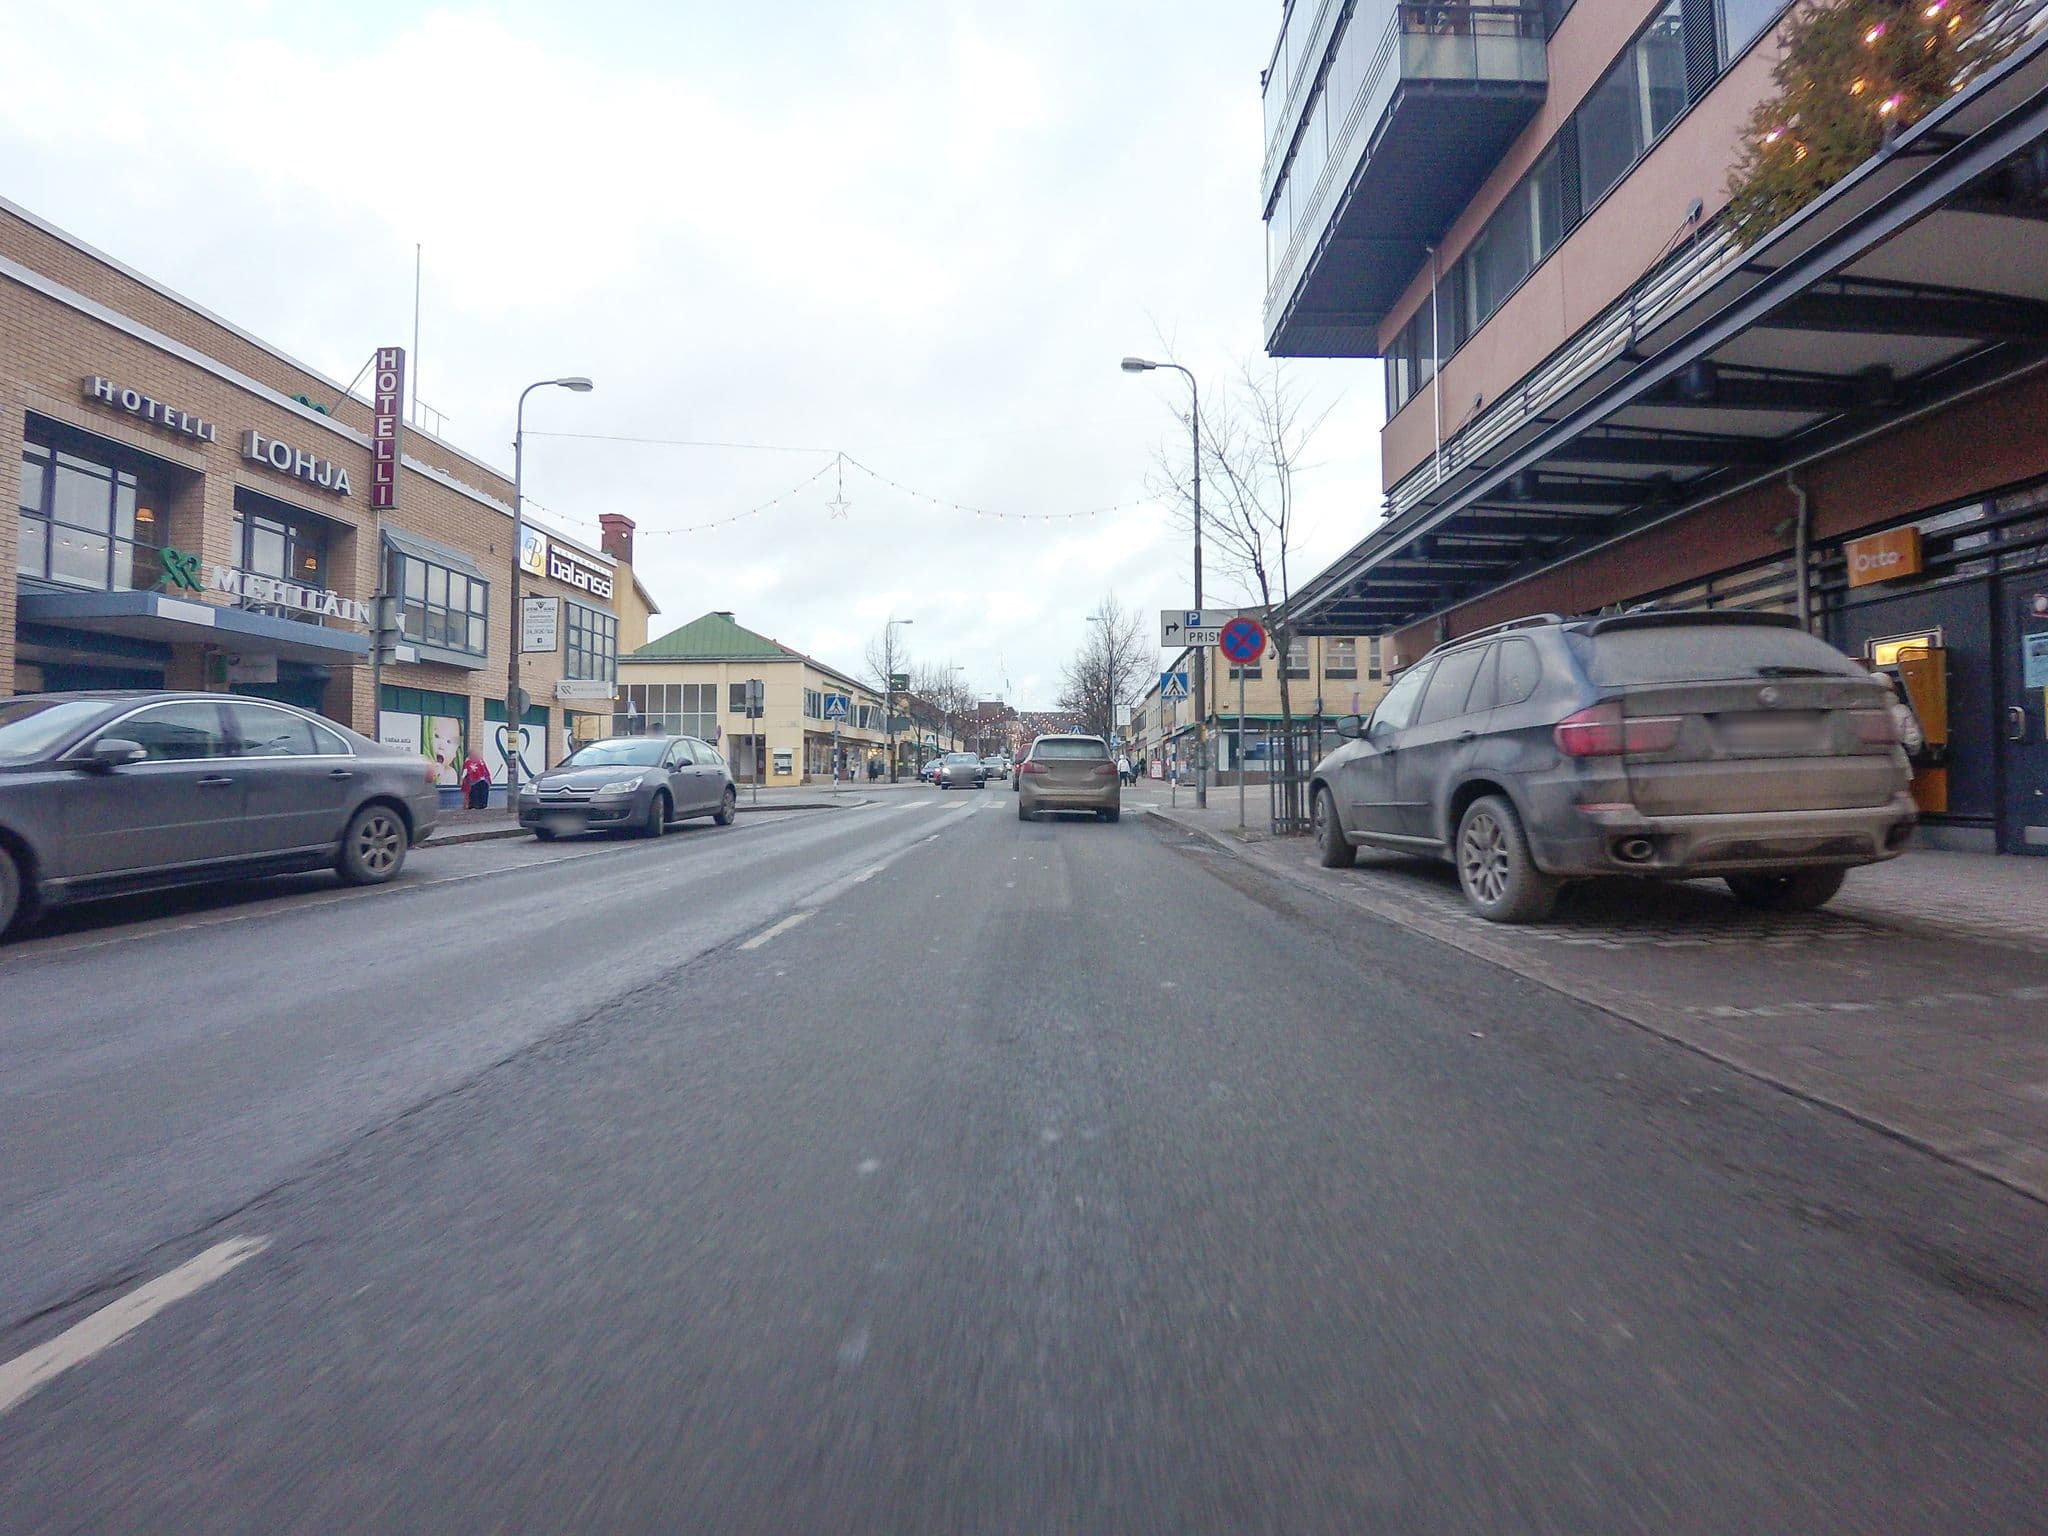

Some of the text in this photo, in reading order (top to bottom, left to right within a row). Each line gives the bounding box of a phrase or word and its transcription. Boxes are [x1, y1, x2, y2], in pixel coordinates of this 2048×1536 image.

[93, 376, 353, 496] HOTELLI LOHJA
[376, 349, 398, 505] HOTELLI
[550, 552, 613, 599] balanssi
[1189, 613, 1199, 625] P
